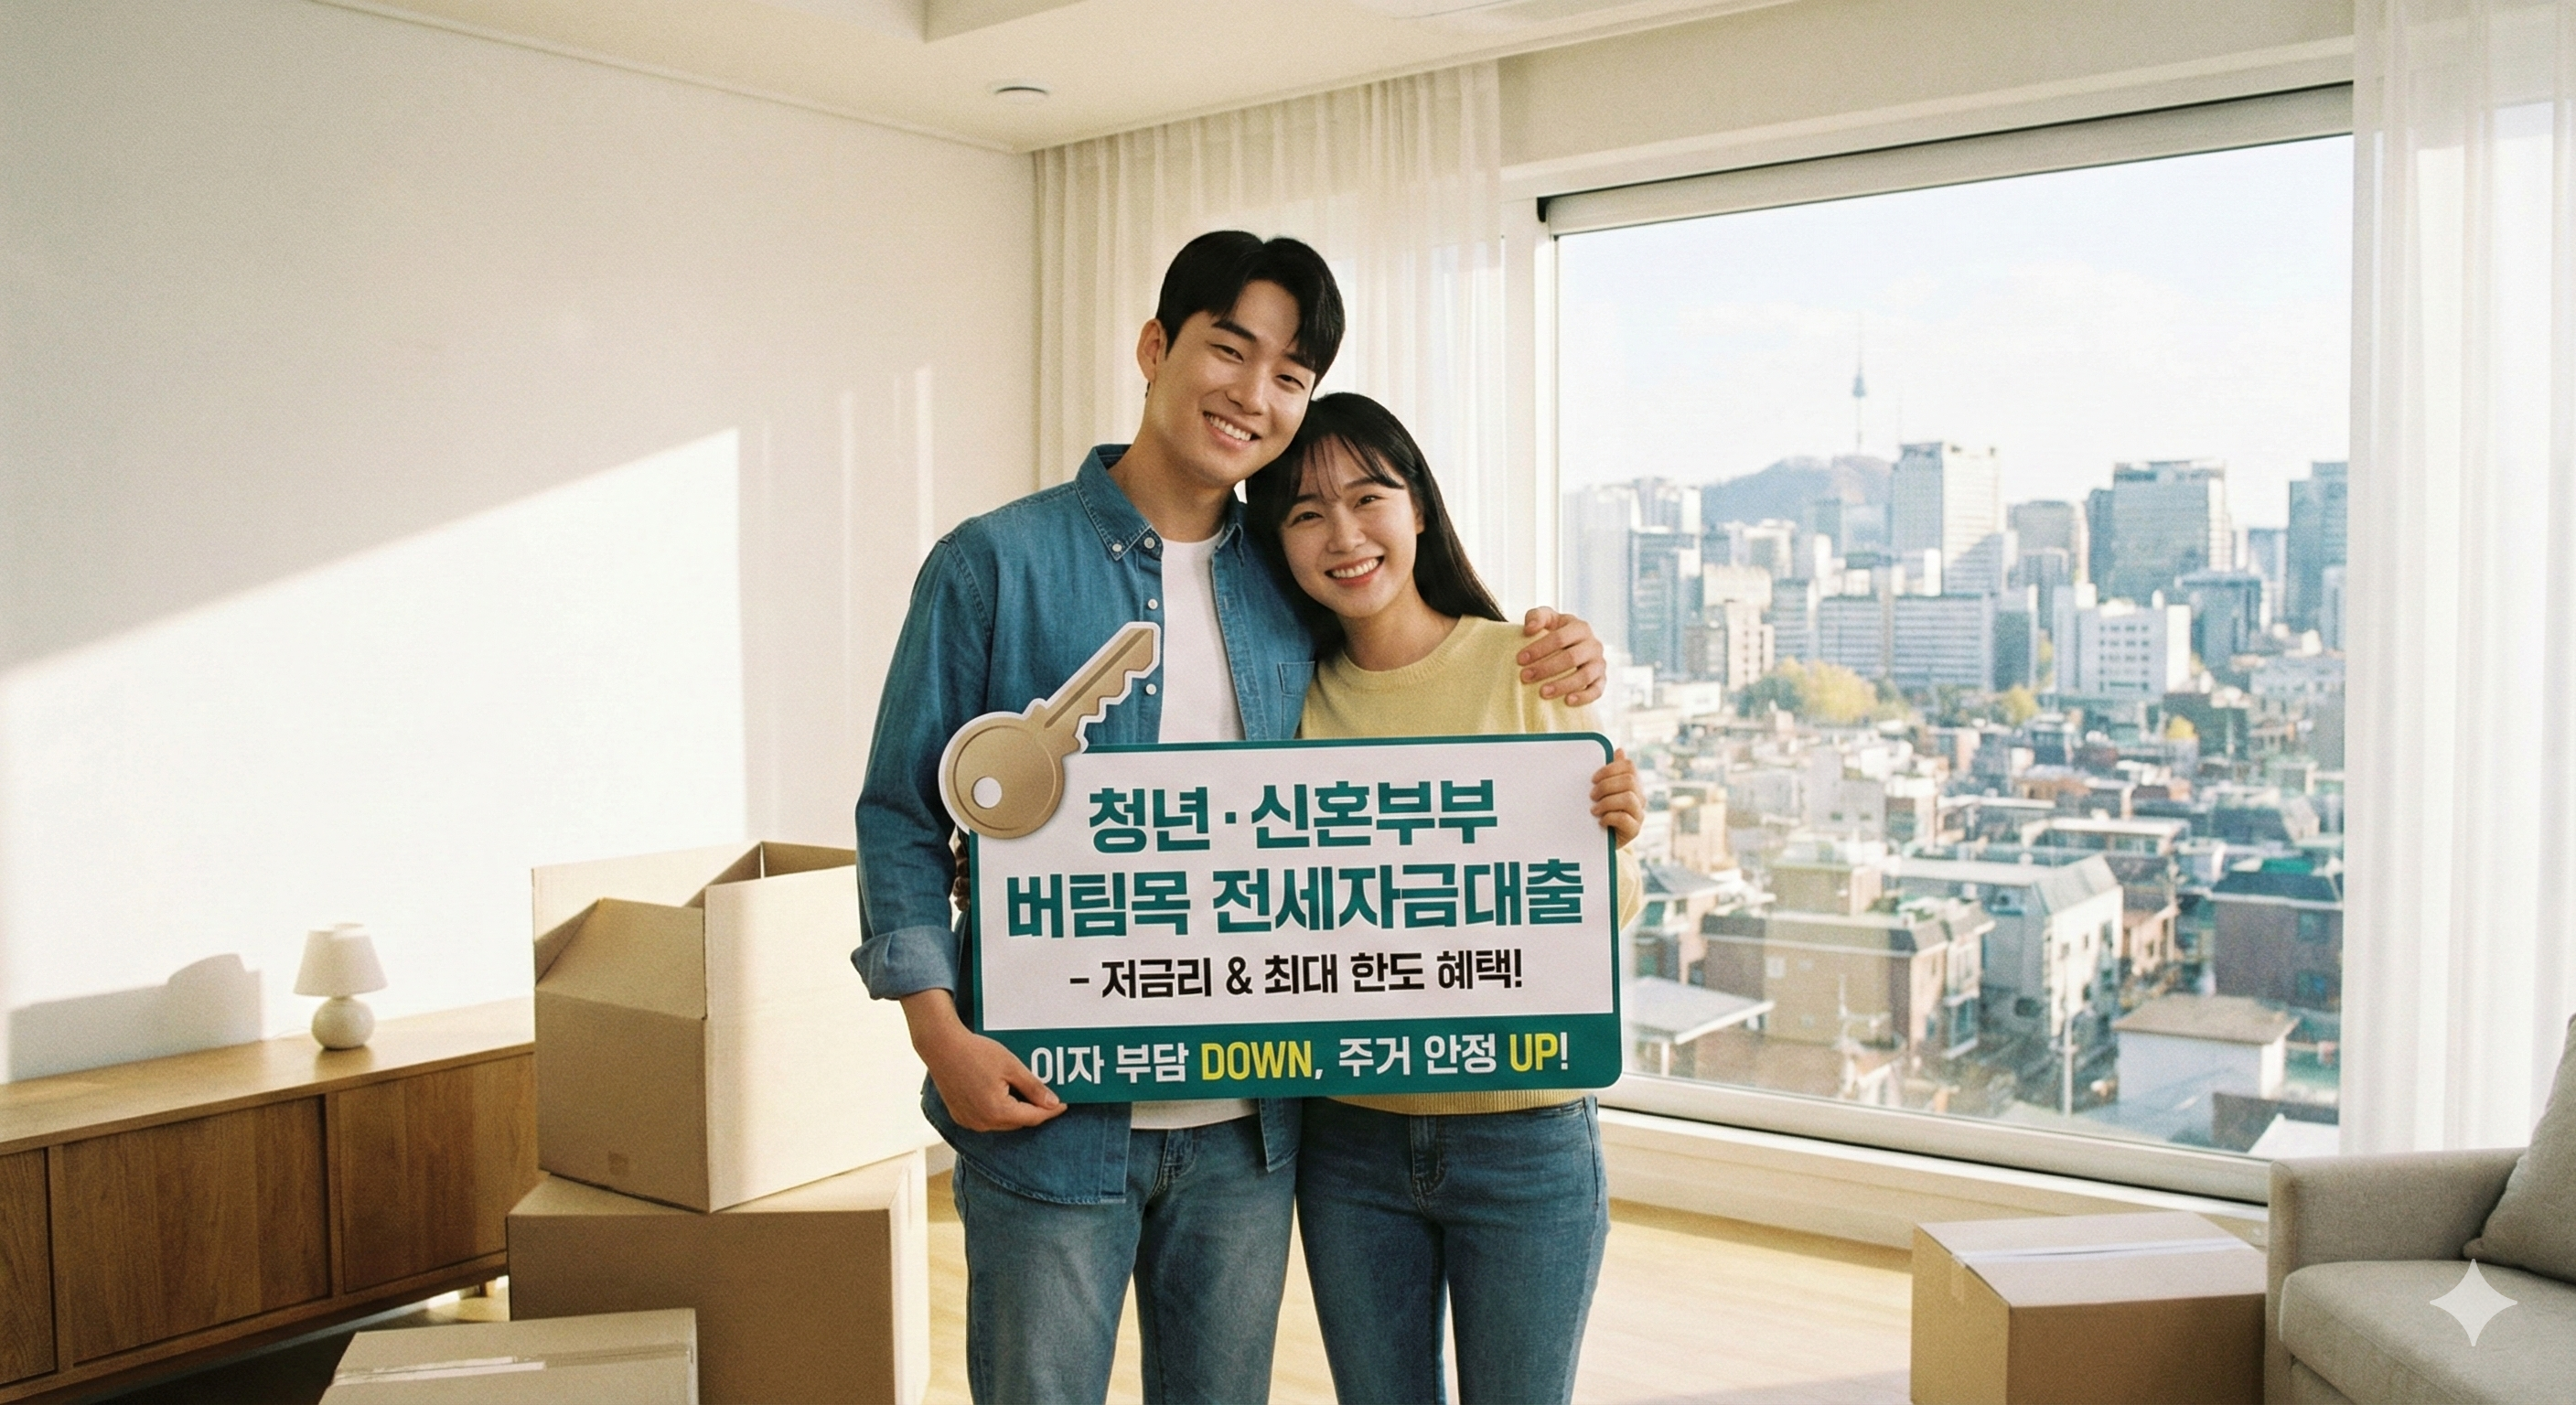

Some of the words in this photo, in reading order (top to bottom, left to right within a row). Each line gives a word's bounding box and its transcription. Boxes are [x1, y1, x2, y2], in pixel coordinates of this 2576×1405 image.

[1007, 871, 1190, 938] 버팀목
[1213, 859, 1583, 933] 전세자금대출
[1102, 958, 1211, 998] 저금리
[1226, 957, 1252, 995] &
[1265, 954, 1337, 994] 최대
[1351, 952, 1424, 992] 한도
[1437, 949, 1521, 989] 혜택!
[1031, 1046, 1104, 1085] 이자
[1116, 1043, 1188, 1083] 부담
[1202, 1041, 1323, 1079] DOWN,
[1339, 1036, 1410, 1077] 주거
[1425, 1034, 1496, 1074] 안정
[1510, 1033, 1567, 1071] UP!
